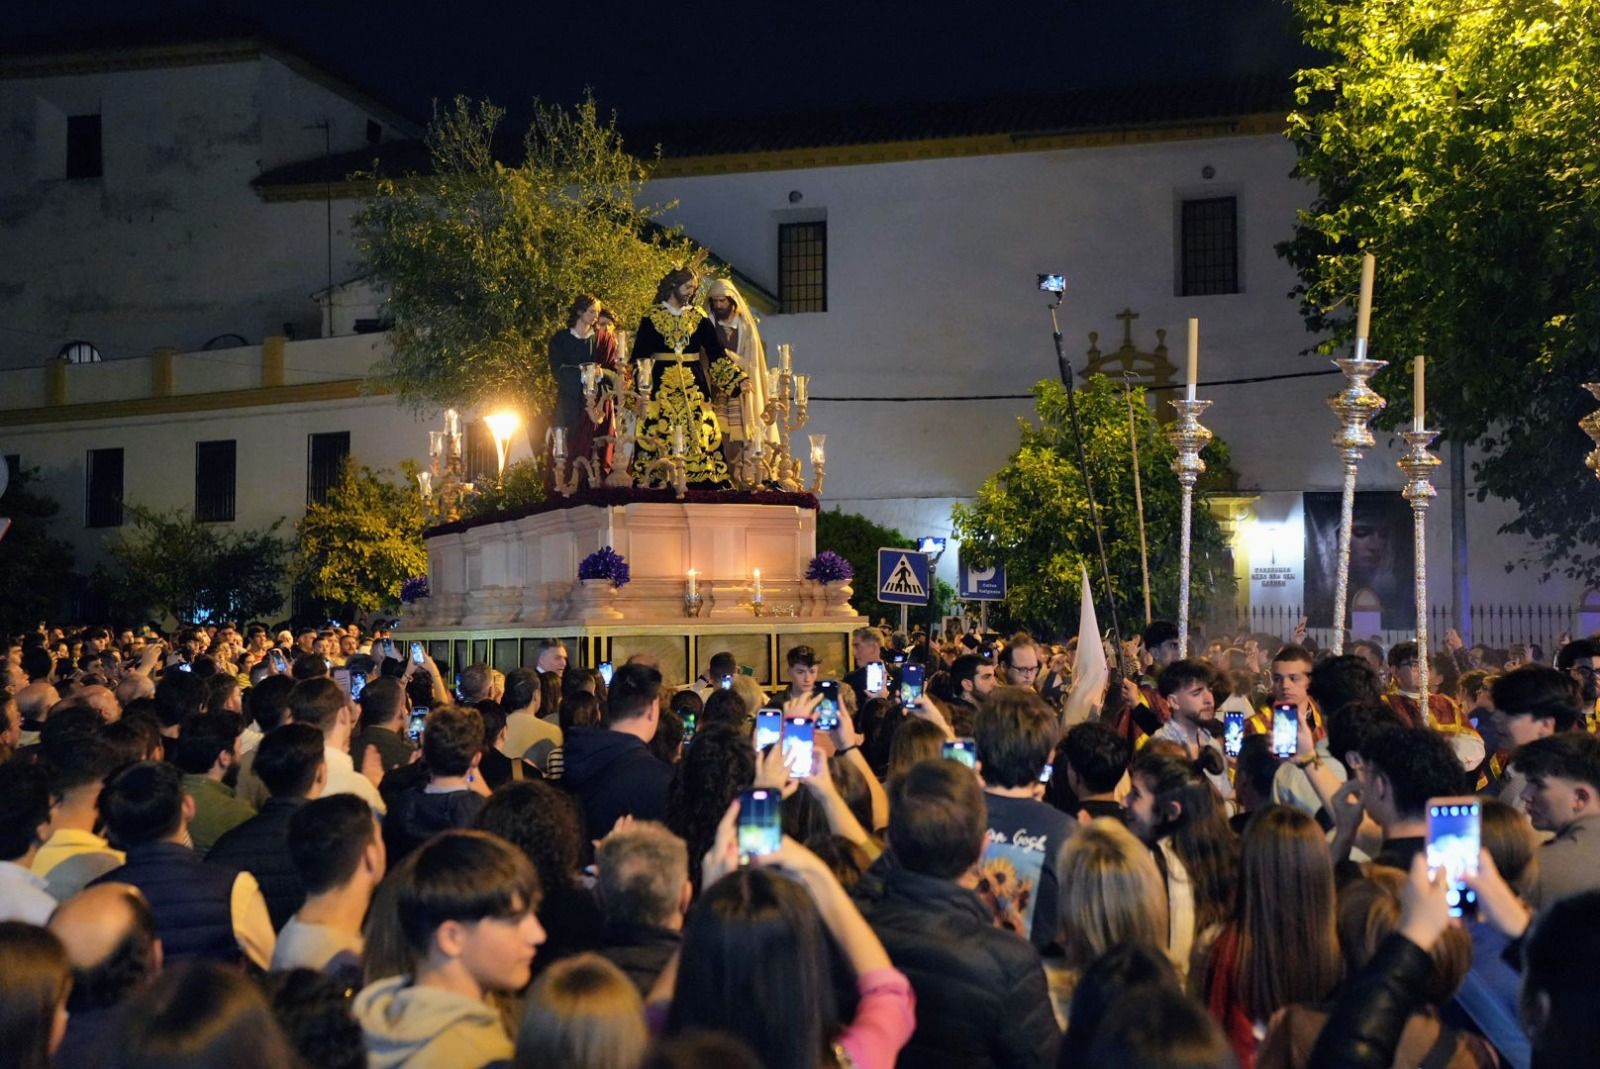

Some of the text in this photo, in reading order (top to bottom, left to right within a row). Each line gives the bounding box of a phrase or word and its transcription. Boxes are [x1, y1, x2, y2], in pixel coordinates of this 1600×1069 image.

[968, 564, 996, 593] P
[986, 827, 1047, 853] an Gogh
